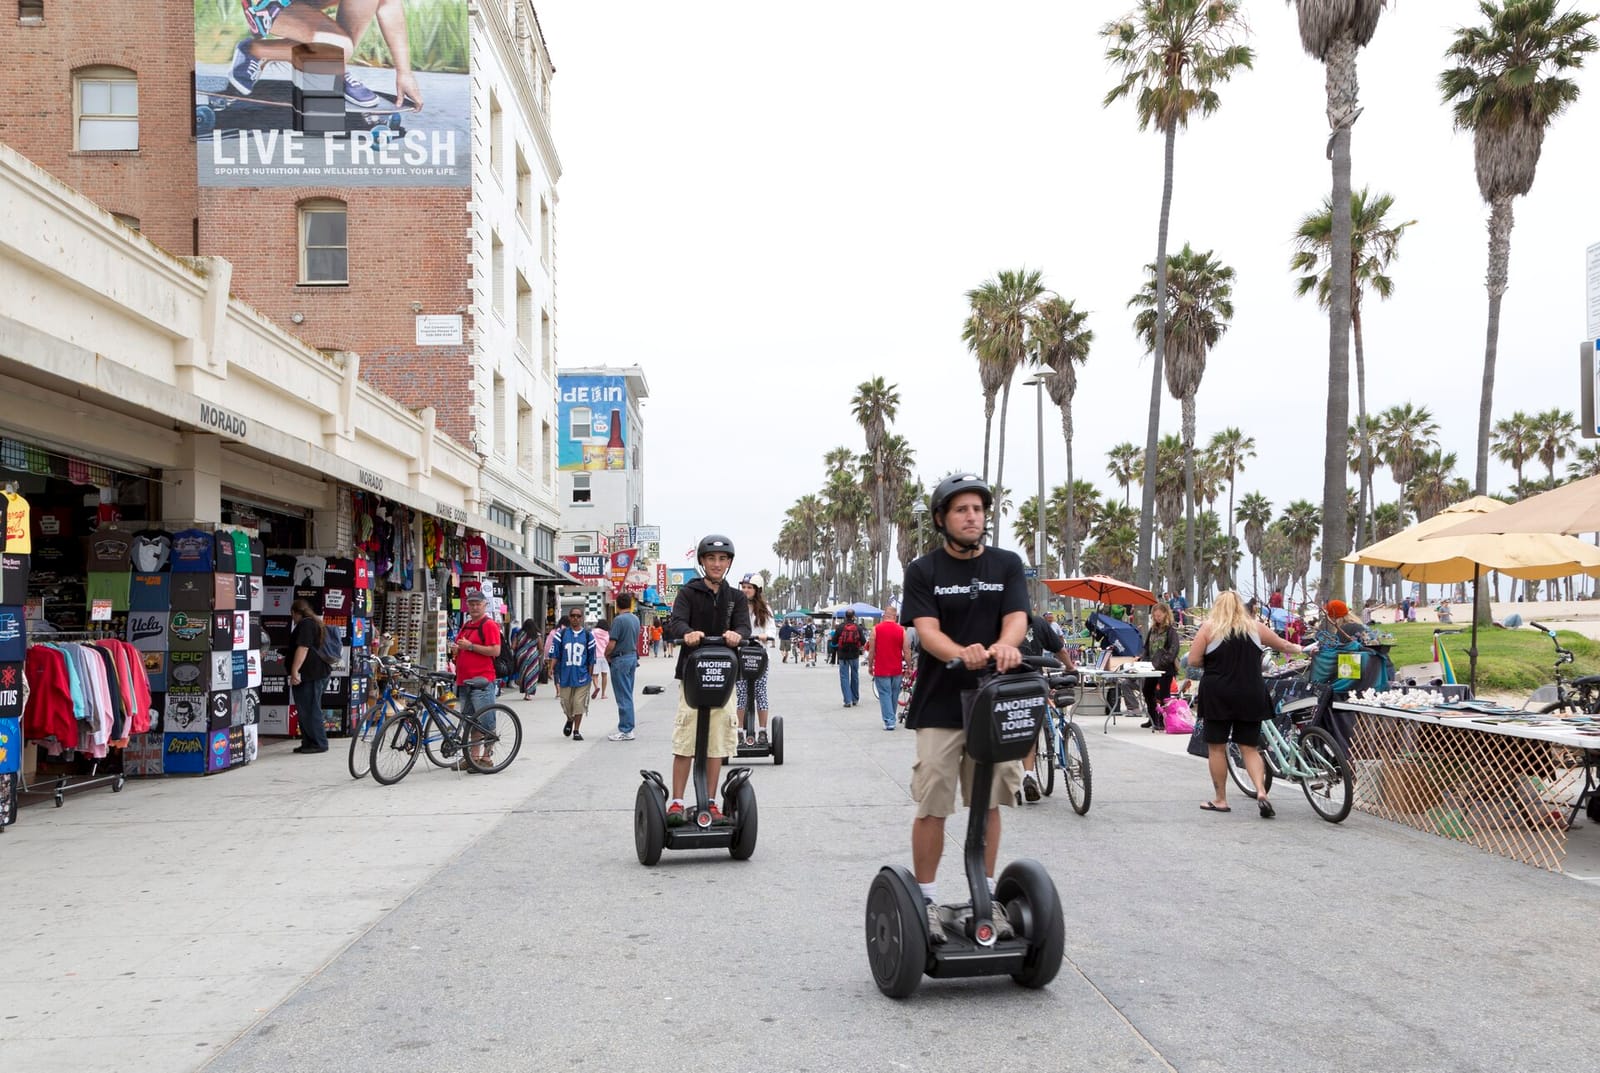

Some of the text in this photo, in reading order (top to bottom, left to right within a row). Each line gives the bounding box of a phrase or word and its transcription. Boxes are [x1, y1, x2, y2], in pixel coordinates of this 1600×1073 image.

[212, 129, 456, 166] LIVE FRESH
[214, 167, 457, 176] SPORTS NUTRITION AND WELLNESS TO FUEL YOUR LIFE.
[200, 403, 247, 437] MORADO
[359, 469, 384, 491] MORADO
[436, 501, 468, 523] MARINE GOODS
[579, 557, 600, 566] MILK
[578, 566, 600, 576] SHAKE
[934, 585, 971, 595] Another
[976, 581, 1004, 591] Tours
[171, 652, 203, 661] EPIC
[564, 642, 585, 666] 18
[0, 690, 18, 705] TUS
[994, 697, 1044, 712] ANOTHER
[1007, 709, 1032, 720] SIDE
[1001, 718, 1036, 731] TOURS
[168, 738, 203, 753] BATMAN
